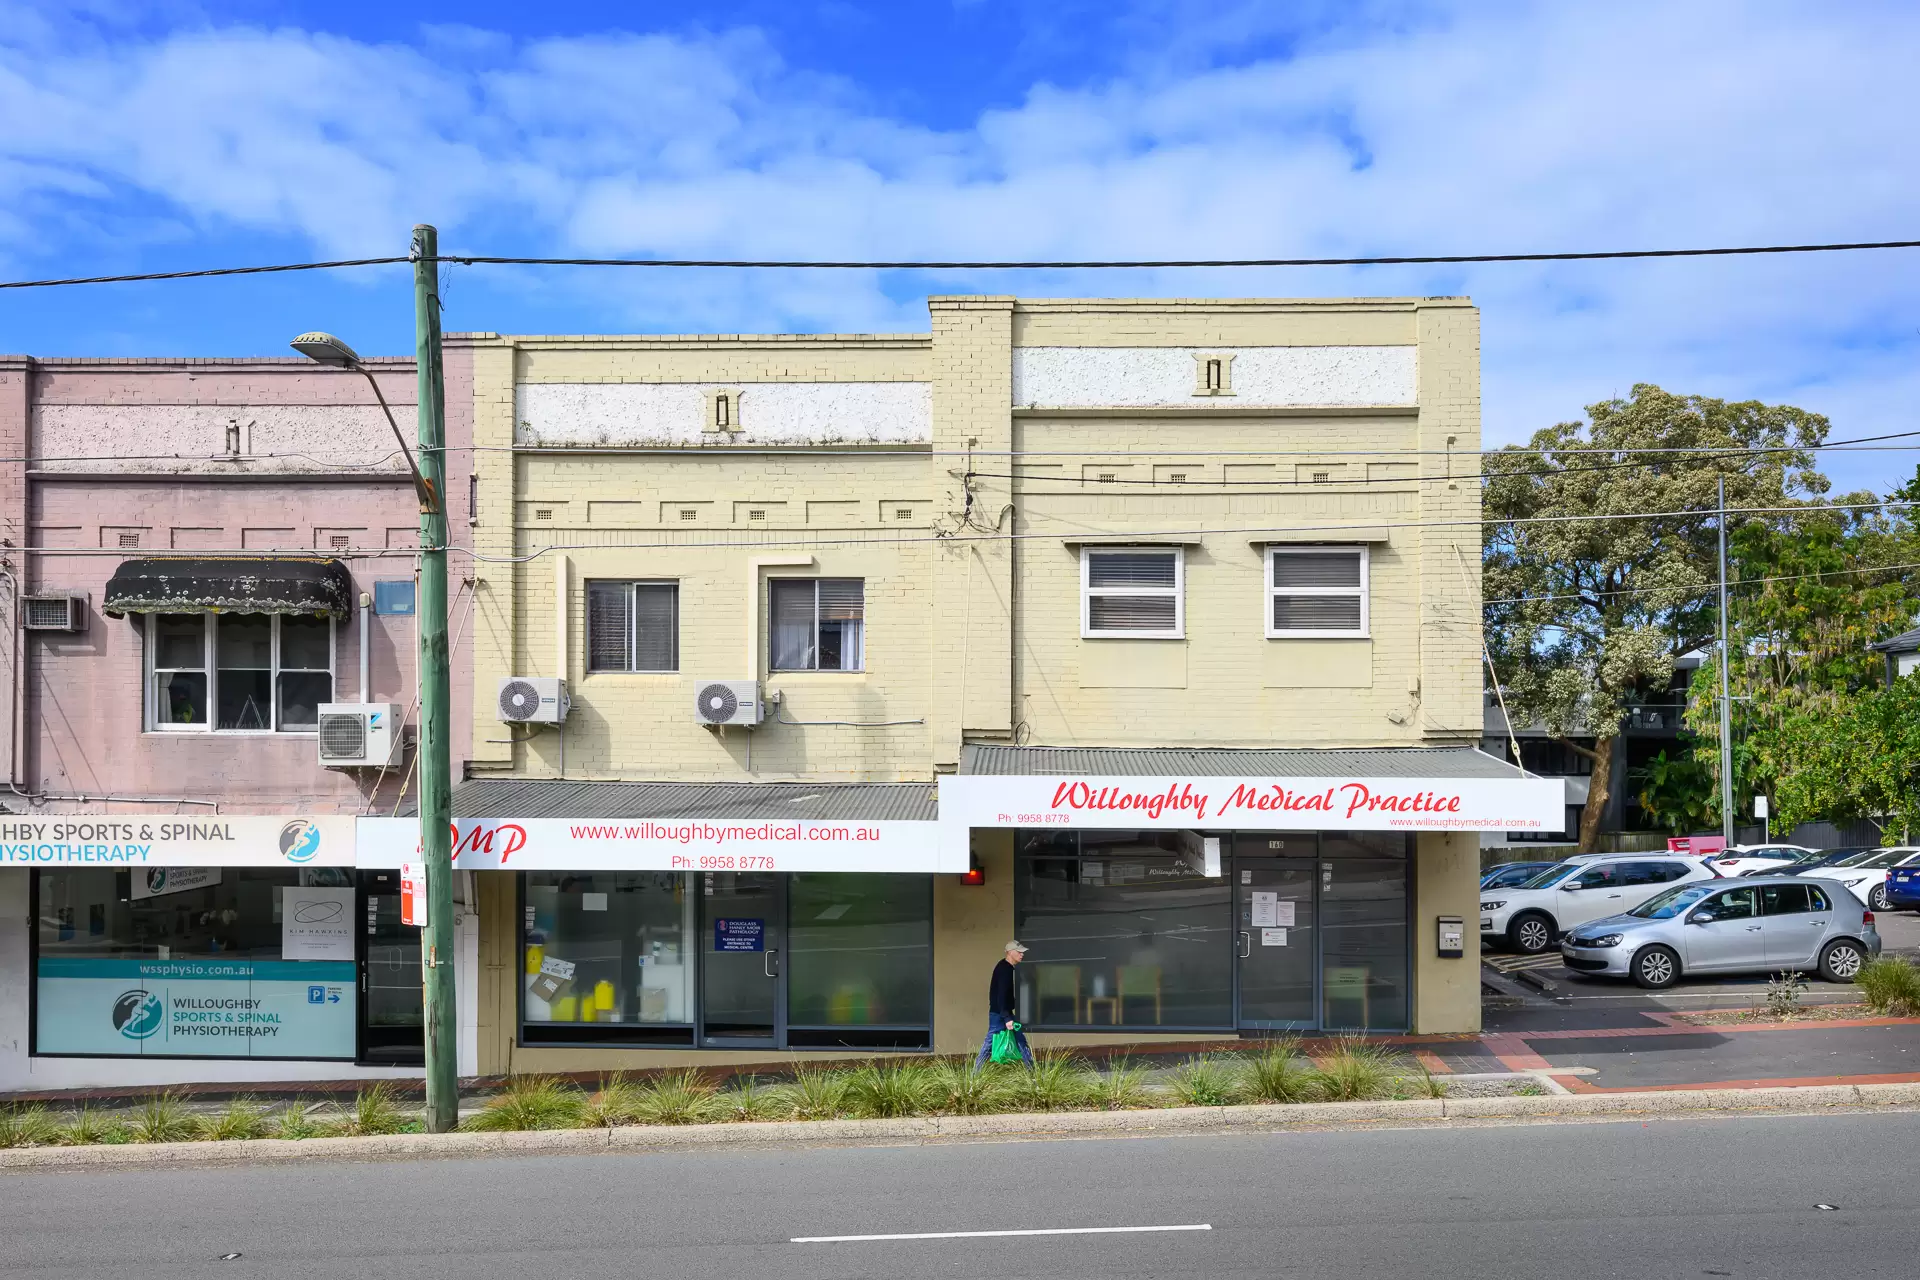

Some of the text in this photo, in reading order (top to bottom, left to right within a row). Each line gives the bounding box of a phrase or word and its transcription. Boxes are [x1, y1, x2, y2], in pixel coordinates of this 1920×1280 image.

[1051, 781, 1461, 819] Willoughby Medical Practice
[1017, 813, 1042, 823] 9958
[1045, 813, 1070, 823] 8778
[1389, 817, 1541, 828] www.willoughbymedical.com.au
[0, 823, 235, 841] HBY SPORTS & SPINAL
[570, 822, 880, 844] www.willoughbymedical.com.au
[672, 856, 775, 869] Ph: 9958 8778
[139, 964, 254, 977] wssphysio.com.au
[173, 998, 261, 1009] WILLOUGHBY
[173, 1012, 282, 1023] SPORTS & SPINAL
[173, 1026, 279, 1037] PHYSIOTHERAPY
